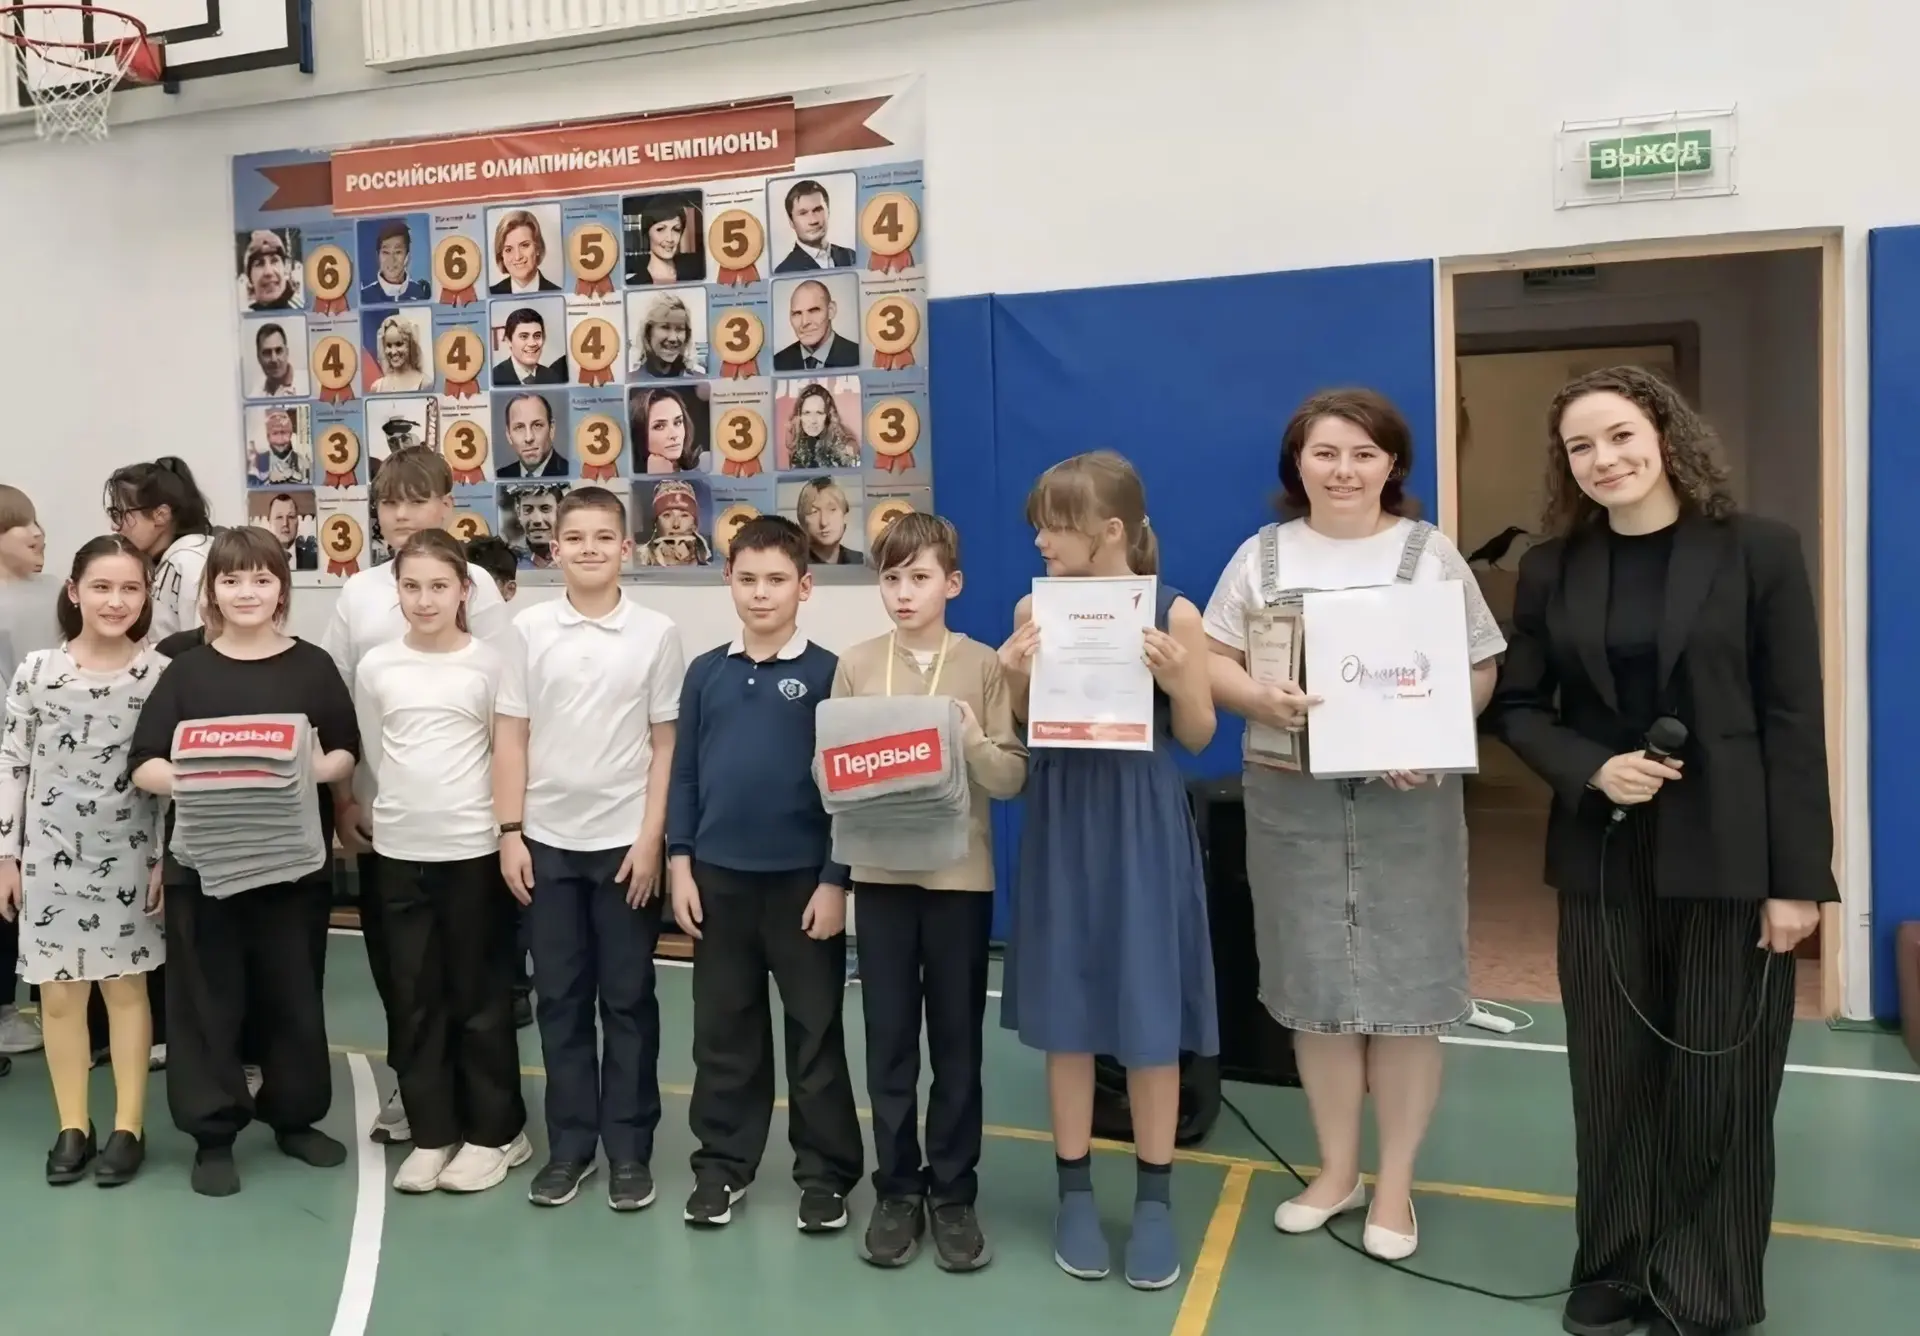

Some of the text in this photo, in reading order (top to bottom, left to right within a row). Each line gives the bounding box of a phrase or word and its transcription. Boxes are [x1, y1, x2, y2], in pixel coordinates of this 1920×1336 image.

[345, 128, 779, 192] РОССИЙСКИЕ ОЛИМПИЙСКИЕ ЧЕМПИОНЫ
[1600, 140, 1701, 170] ВЫХОД
[721, 219, 749, 258] 5
[873, 202, 904, 242] 4
[444, 244, 468, 280] 6
[579, 233, 605, 270] 5
[317, 255, 339, 290] 6
[725, 317, 750, 352] 3
[878, 305, 906, 341] 3
[322, 343, 344, 378] 4
[446, 336, 471, 371] 4
[580, 326, 605, 360] 4
[586, 422, 611, 455] 3
[727, 415, 753, 451] 3
[879, 407, 906, 443] 3
[327, 432, 349, 464] 3
[454, 427, 477, 460] 3
[331, 520, 351, 552] 3
[188, 729, 285, 746] Первые
[832, 741, 931, 778] Первые
